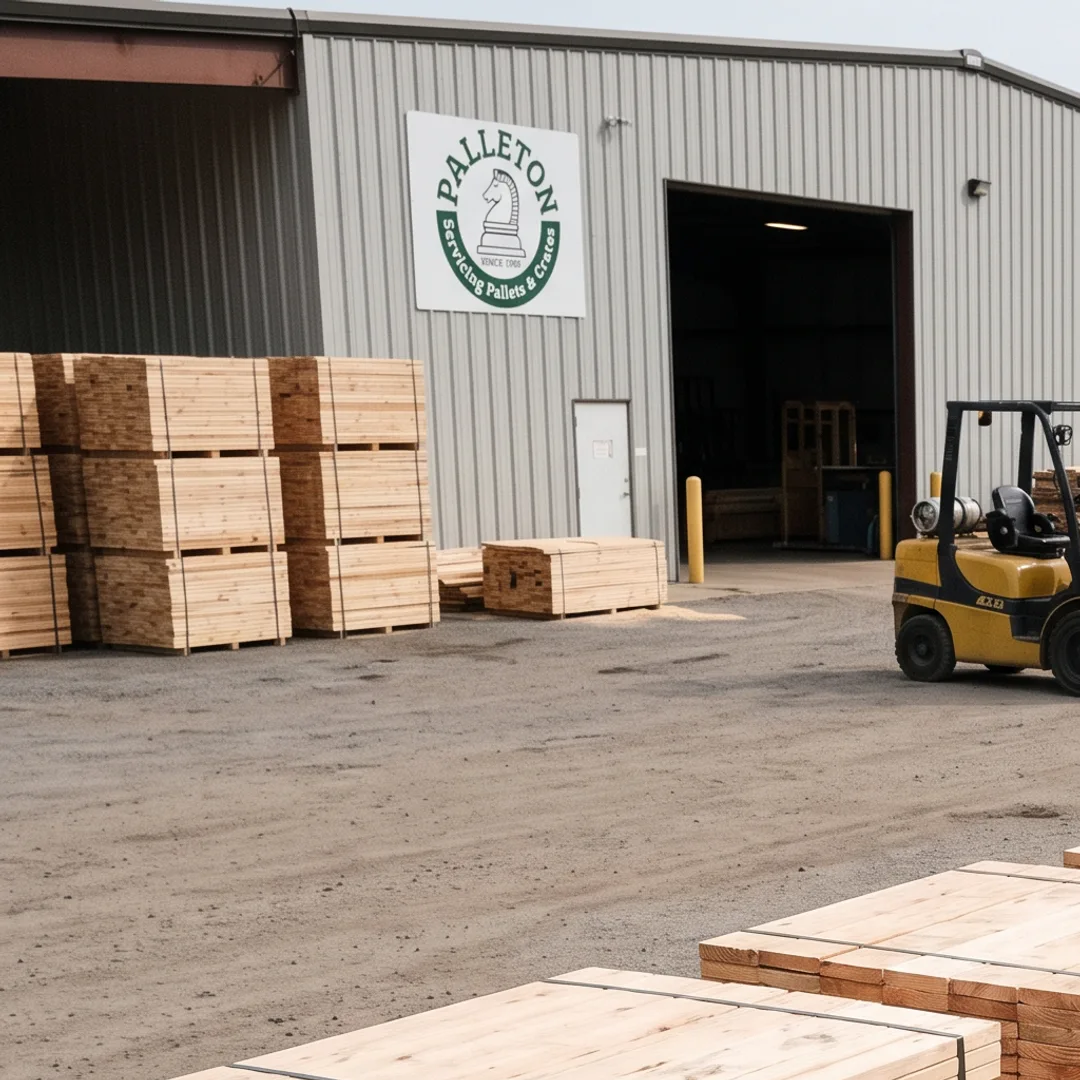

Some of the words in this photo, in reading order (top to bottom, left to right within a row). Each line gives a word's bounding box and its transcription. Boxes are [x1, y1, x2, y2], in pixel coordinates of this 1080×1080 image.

[437, 129, 558, 215] PALLETON
[443, 219, 484, 296] Servicing
[486, 282, 526, 300] Pallets
[526, 276, 537, 290] &
